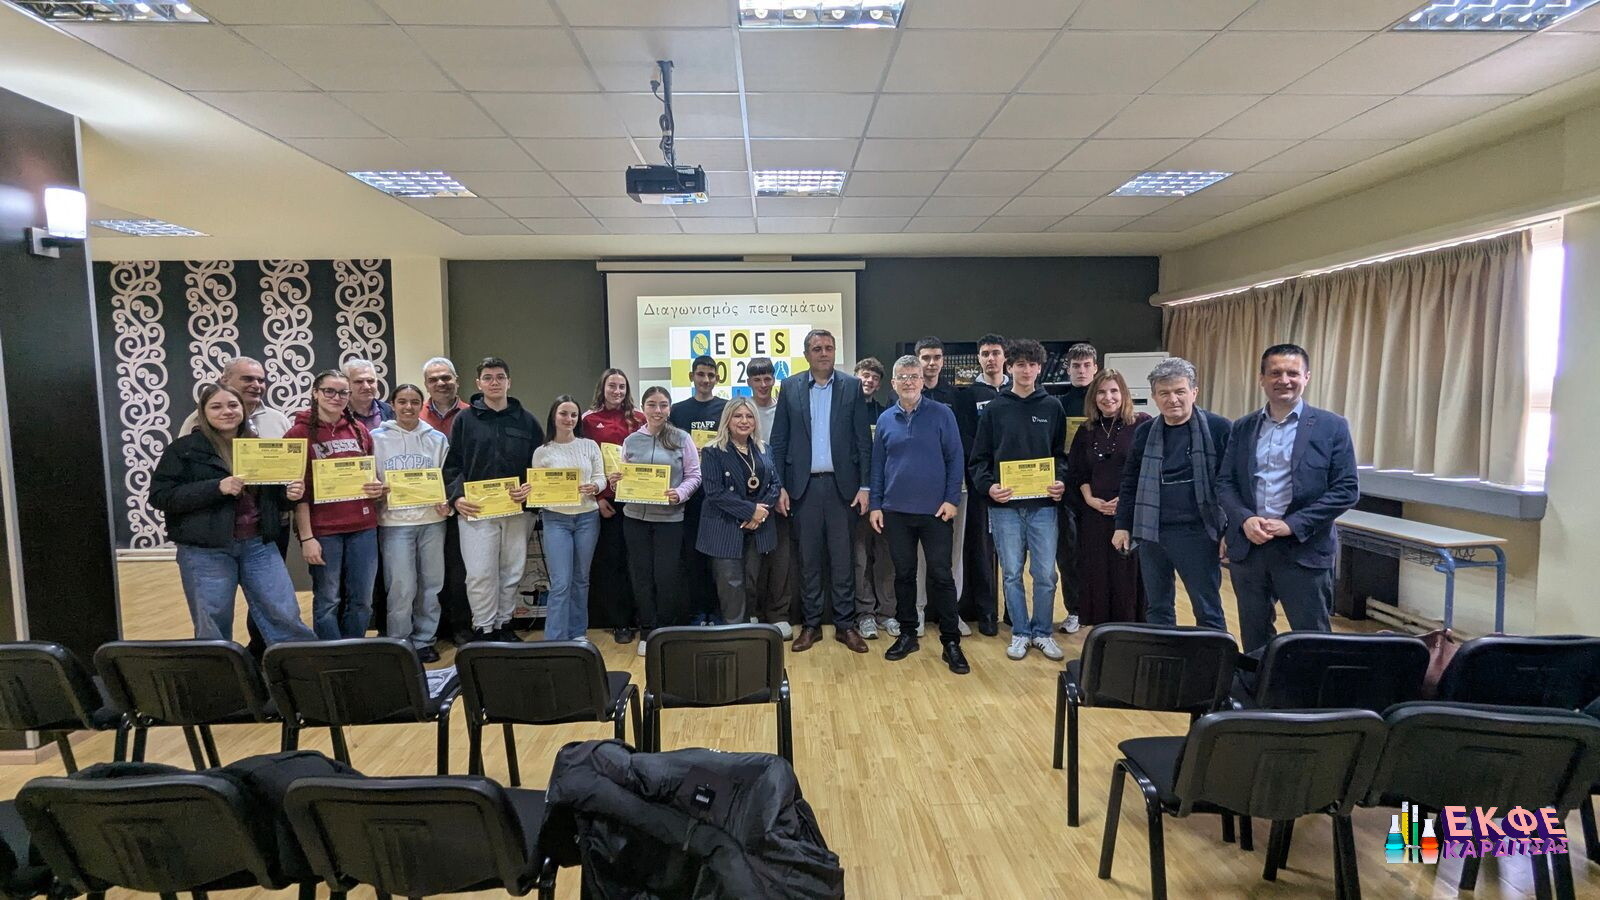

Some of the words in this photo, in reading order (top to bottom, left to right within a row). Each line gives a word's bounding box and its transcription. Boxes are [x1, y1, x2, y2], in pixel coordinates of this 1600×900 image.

[644, 303, 738, 318] Διαγωνισμός
[749, 300, 835, 316] πειραμάτων
[715, 332, 786, 354] EOES
[691, 420, 716, 429] STAFF
